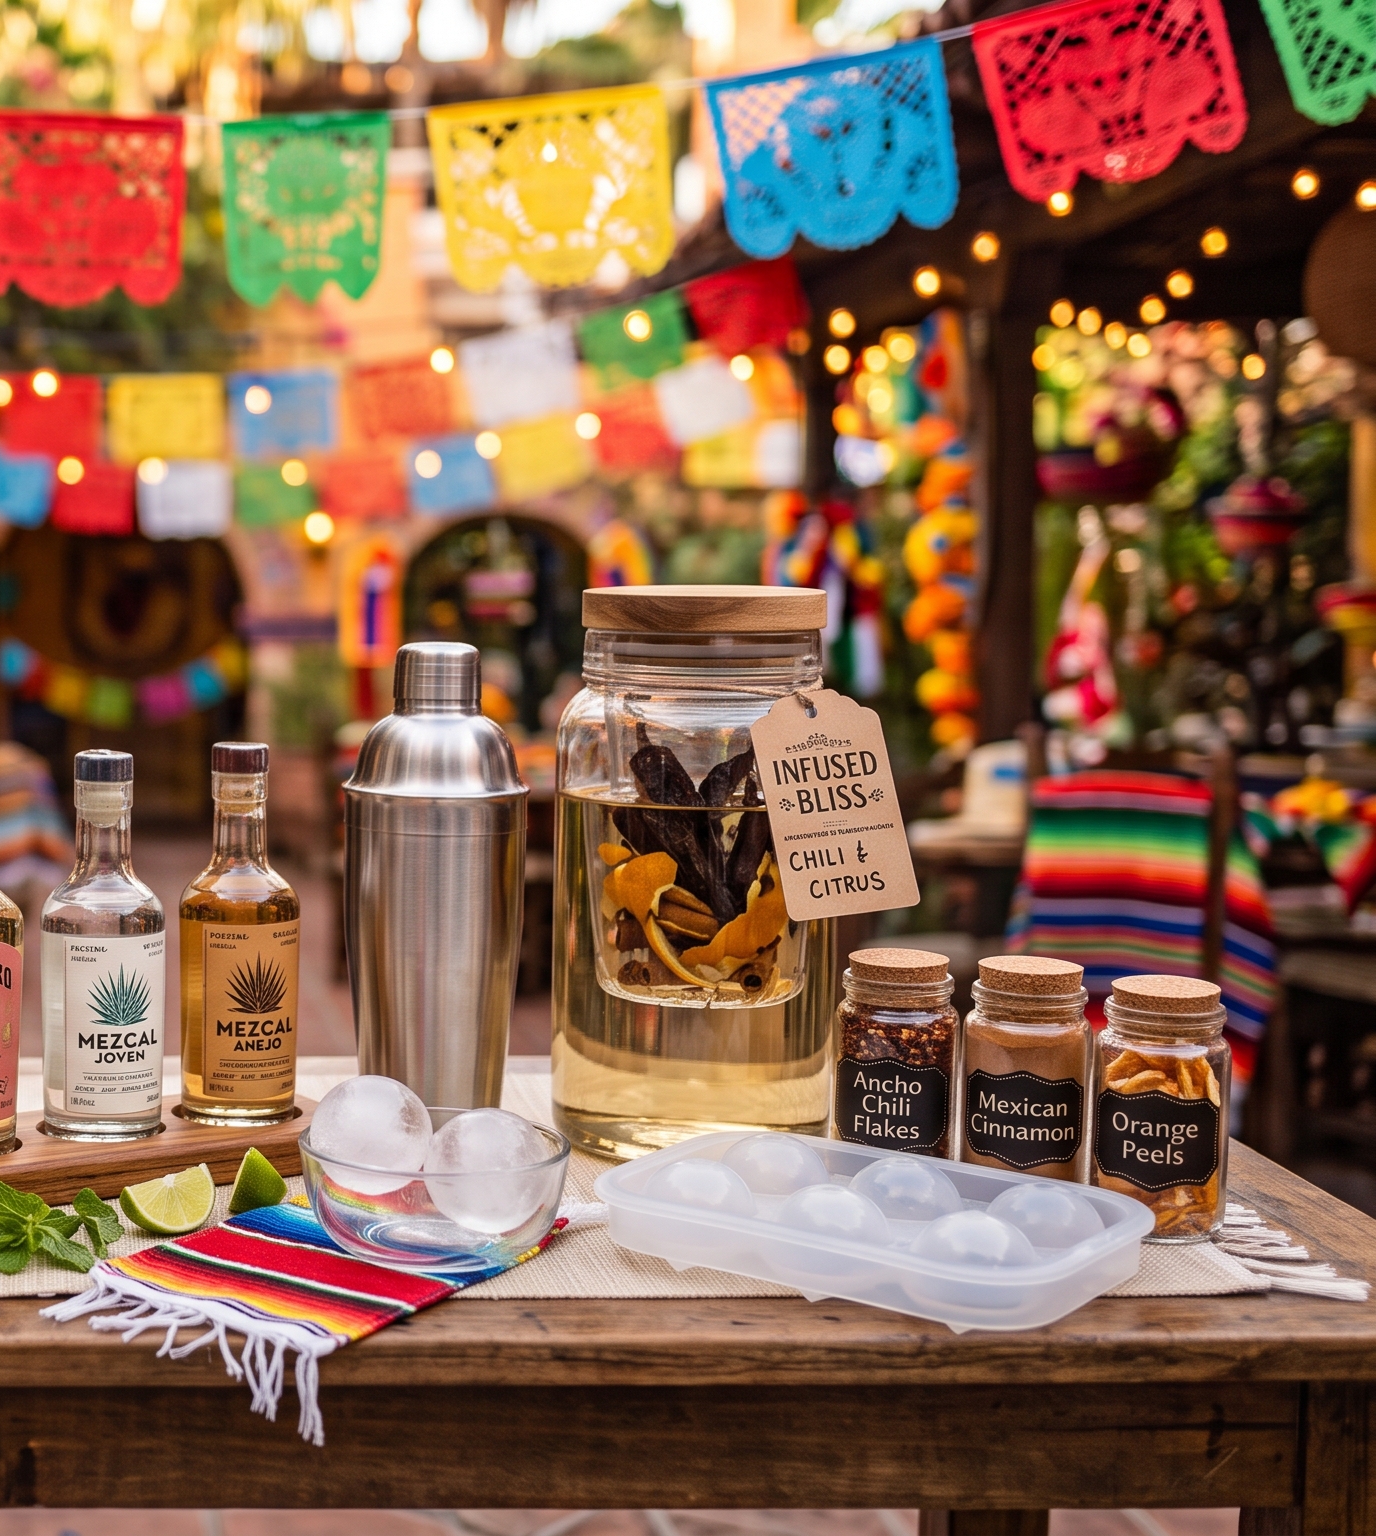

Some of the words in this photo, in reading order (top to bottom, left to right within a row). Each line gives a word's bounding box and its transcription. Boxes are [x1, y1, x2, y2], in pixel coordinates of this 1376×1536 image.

[773, 751, 878, 786] INFUSED
[796, 783, 868, 814] BLISS
[789, 847, 845, 872] CHILI
[809, 871, 886, 899] CITRUS
[216, 1016, 293, 1037] MEZCAL
[78, 1029, 158, 1050] MEZCAL
[233, 1038, 282, 1052] ANEJO
[94, 1049, 145, 1064] JOVEN
[853, 1071, 922, 1095] Ancho
[862, 1094, 911, 1117] Chili
[979, 1090, 1068, 1117] Mexican
[854, 1114, 920, 1139] Flakes
[971, 1113, 1074, 1141] Cinnamon
[1112, 1111, 1199, 1145] Orange
[1122, 1139, 1185, 1165] Peels
